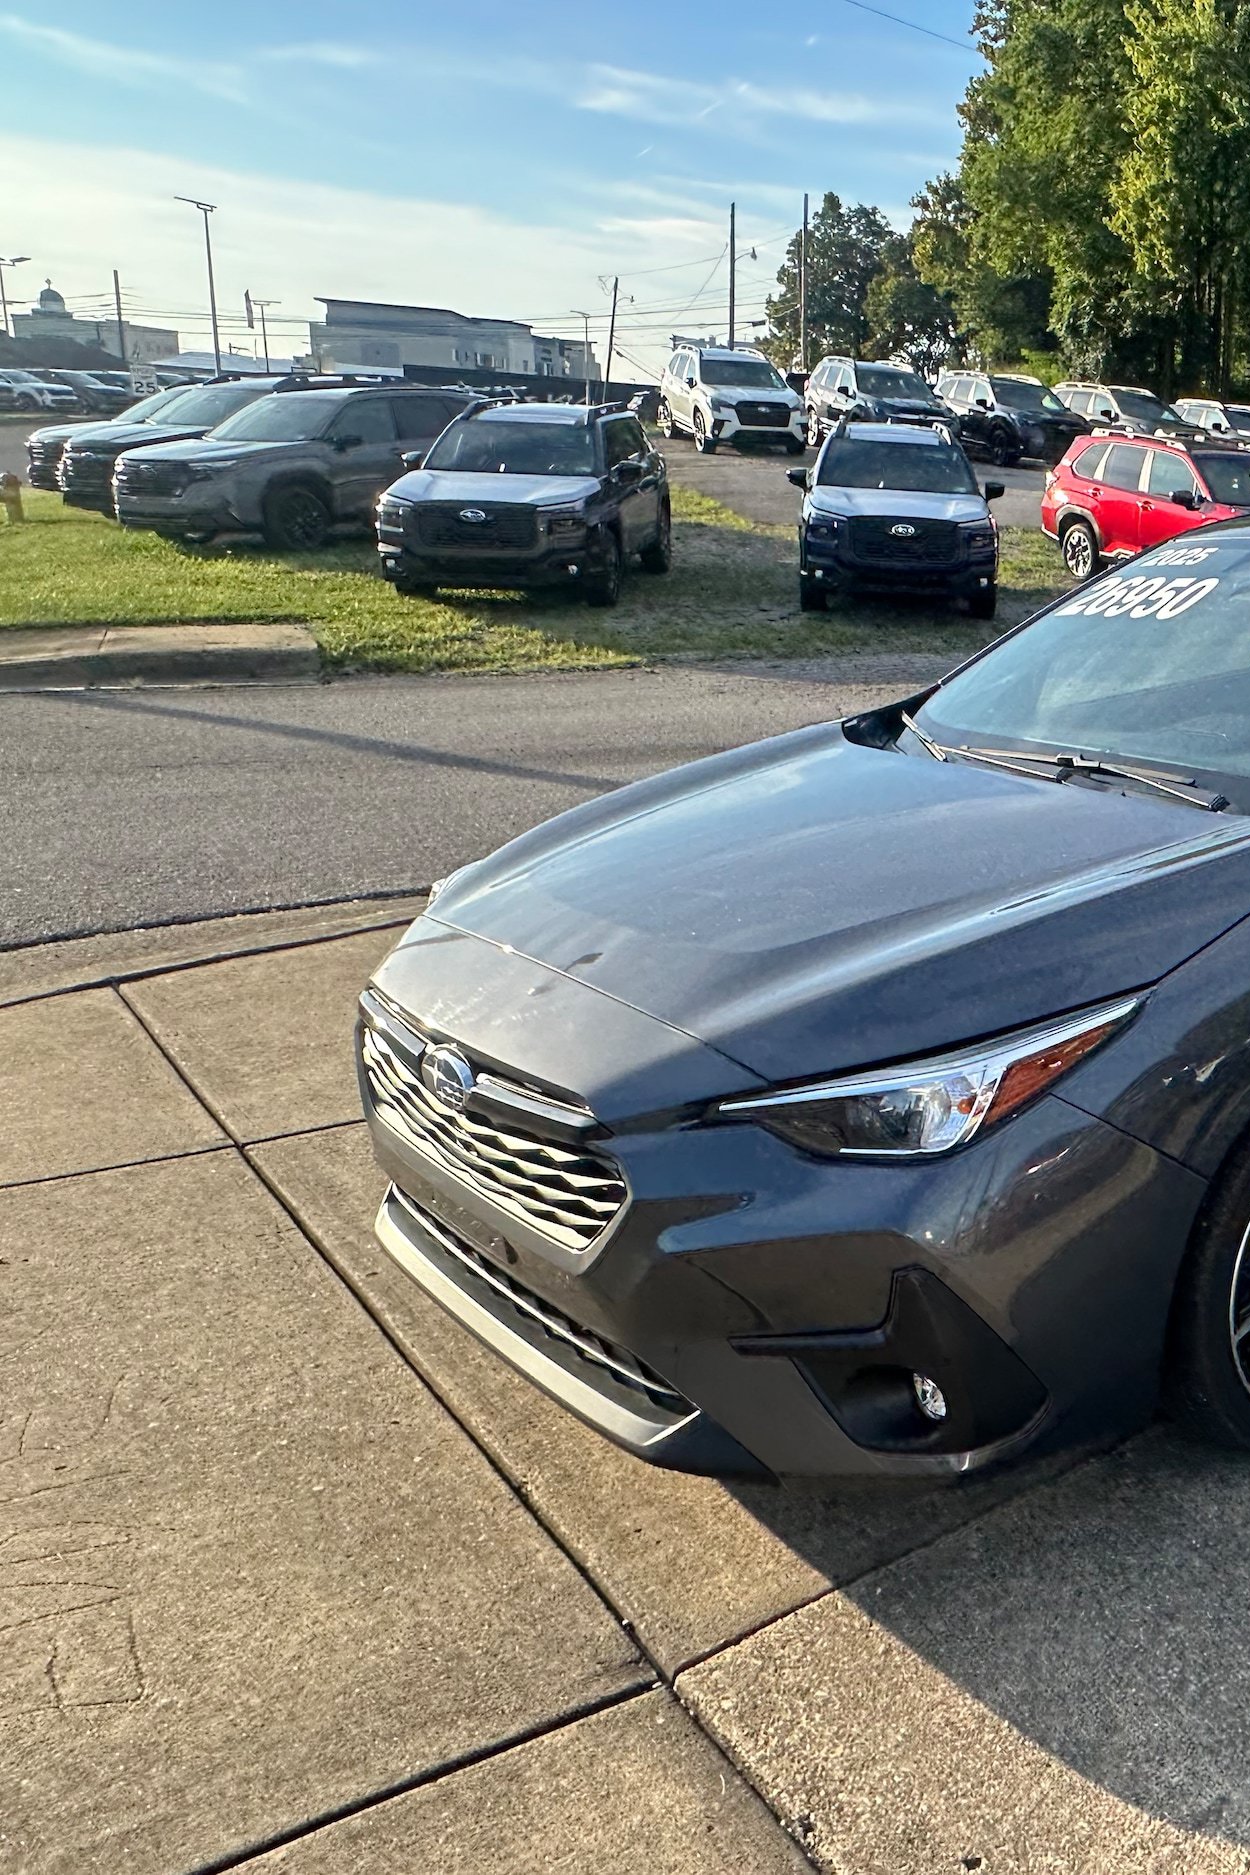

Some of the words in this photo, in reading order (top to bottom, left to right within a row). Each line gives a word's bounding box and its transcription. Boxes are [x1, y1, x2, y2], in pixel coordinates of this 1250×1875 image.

[134, 381, 156, 393] 25
[1140, 547, 1219, 567] 2025
[1054, 575, 1220, 620] 26950
